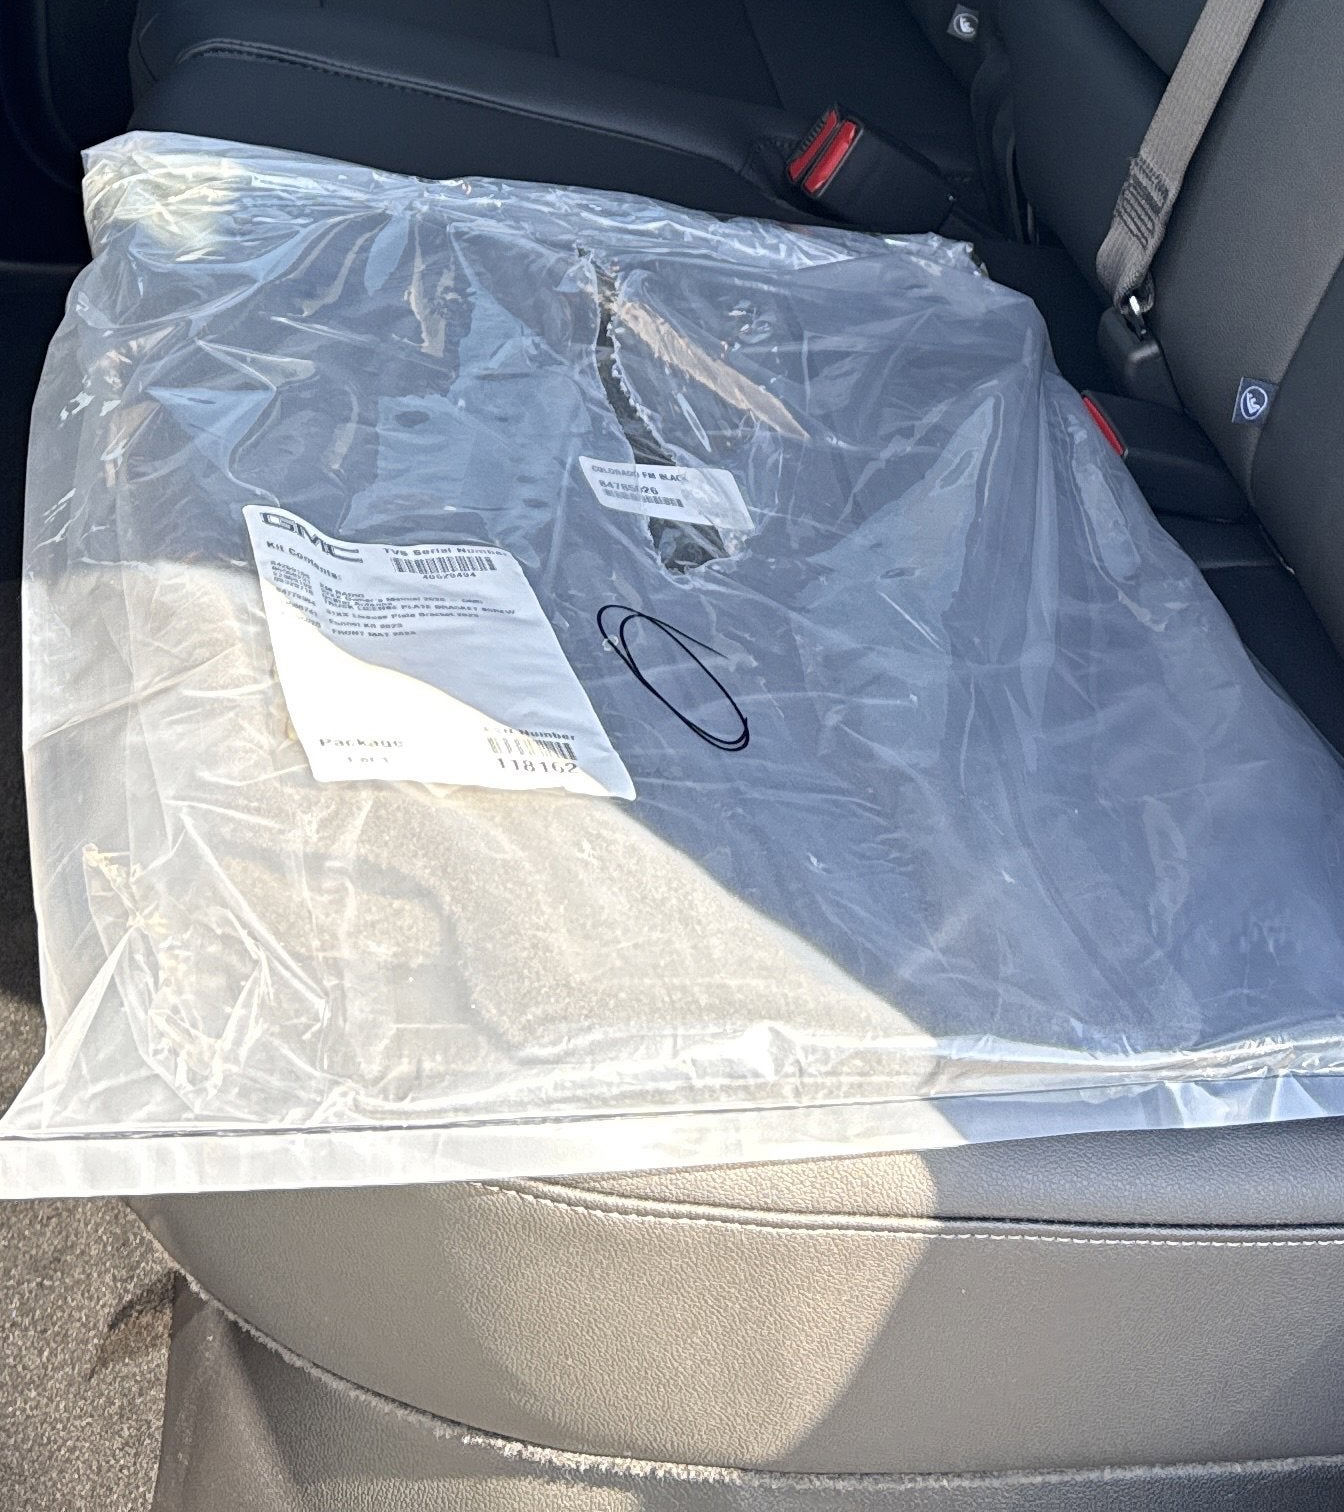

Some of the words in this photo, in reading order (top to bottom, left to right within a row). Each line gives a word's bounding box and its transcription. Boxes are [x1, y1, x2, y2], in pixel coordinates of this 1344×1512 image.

[591, 465, 639, 478] COLORADO
[260, 512, 364, 563] GMC
[266, 540, 285, 553] Kit
[412, 547, 452, 557] Serial
[456, 547, 508, 557] Number
[518, 728, 575, 742] Number
[318, 738, 405, 749] Package
[497, 757, 578, 774] 118162
